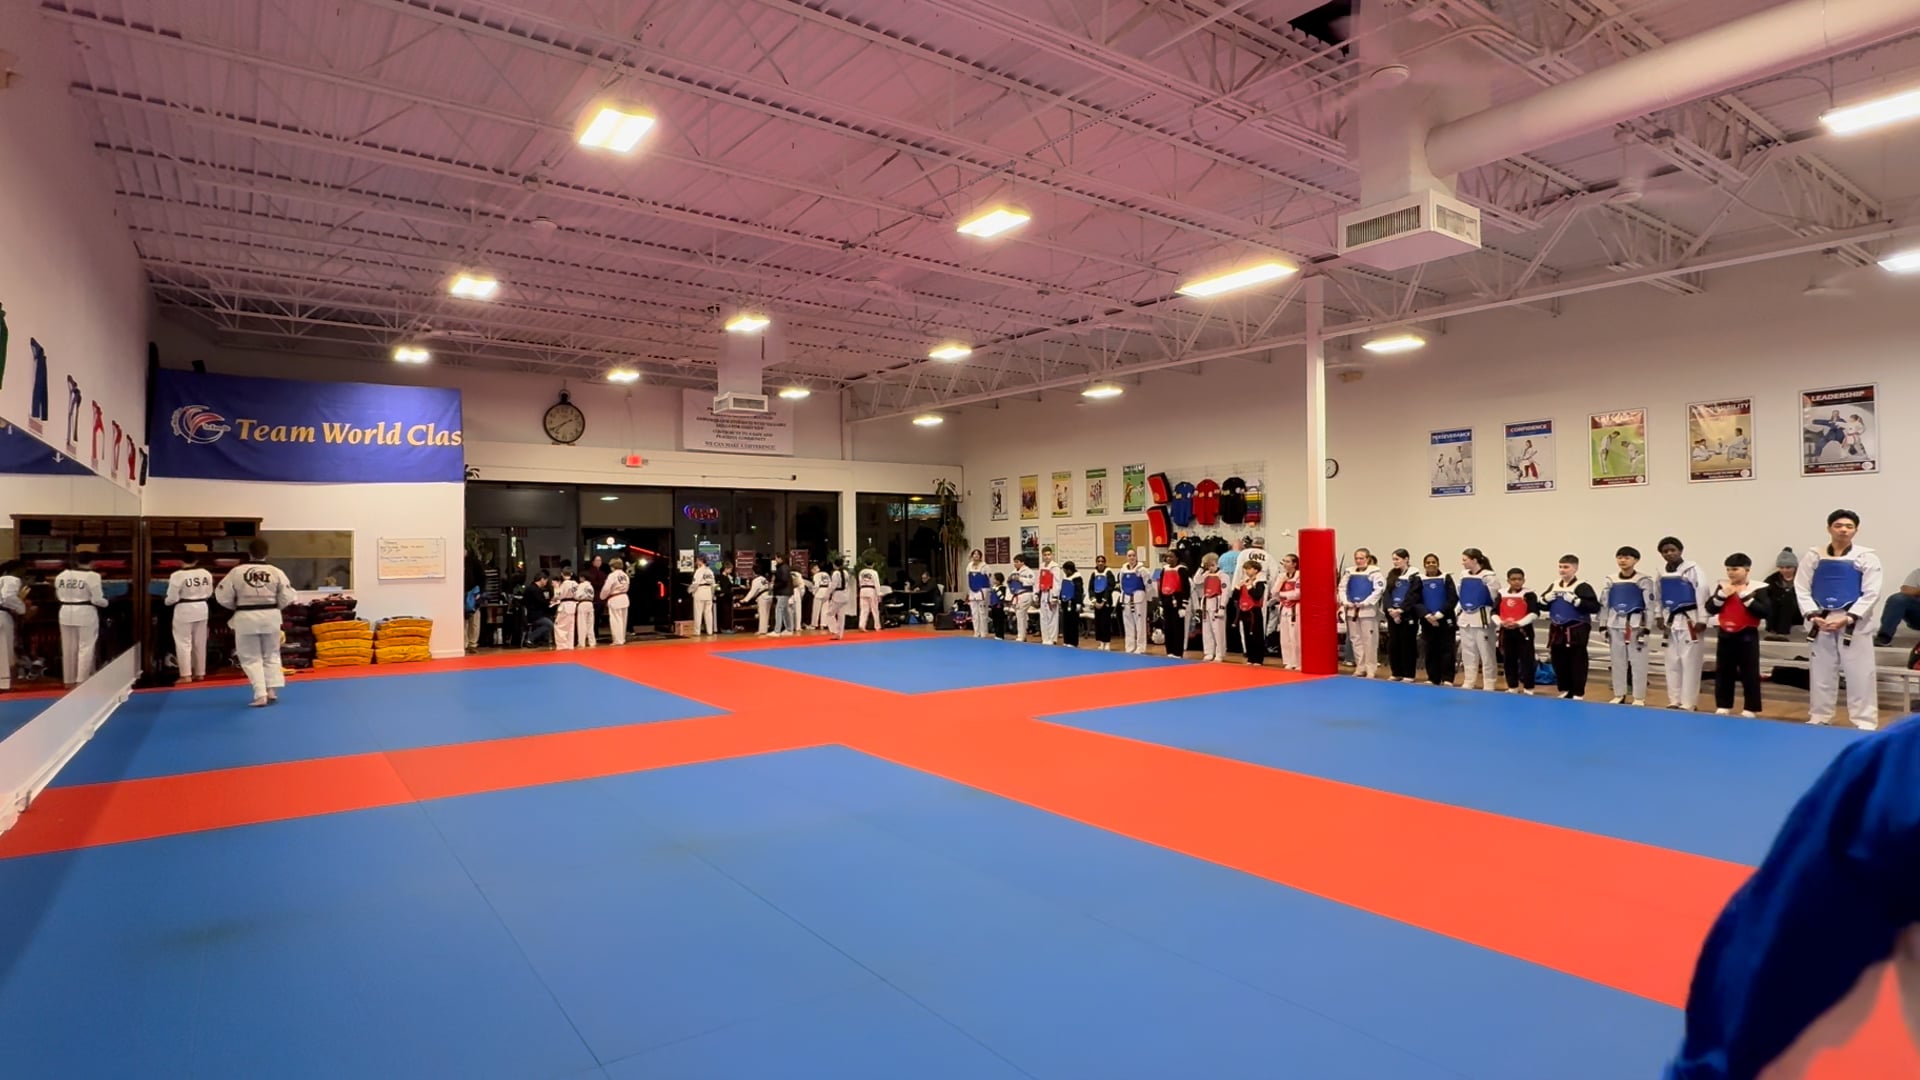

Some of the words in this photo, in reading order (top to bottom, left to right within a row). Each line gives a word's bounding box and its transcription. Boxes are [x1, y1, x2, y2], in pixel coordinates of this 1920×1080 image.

[1811, 391, 1865, 402] LEADERSHIP
[235, 418, 316, 443] Team
[321, 421, 402, 446] World
[1510, 424, 1547, 433] CONFIDENCE
[185, 576, 209, 588] USA
[243, 570, 271, 586] UNI
